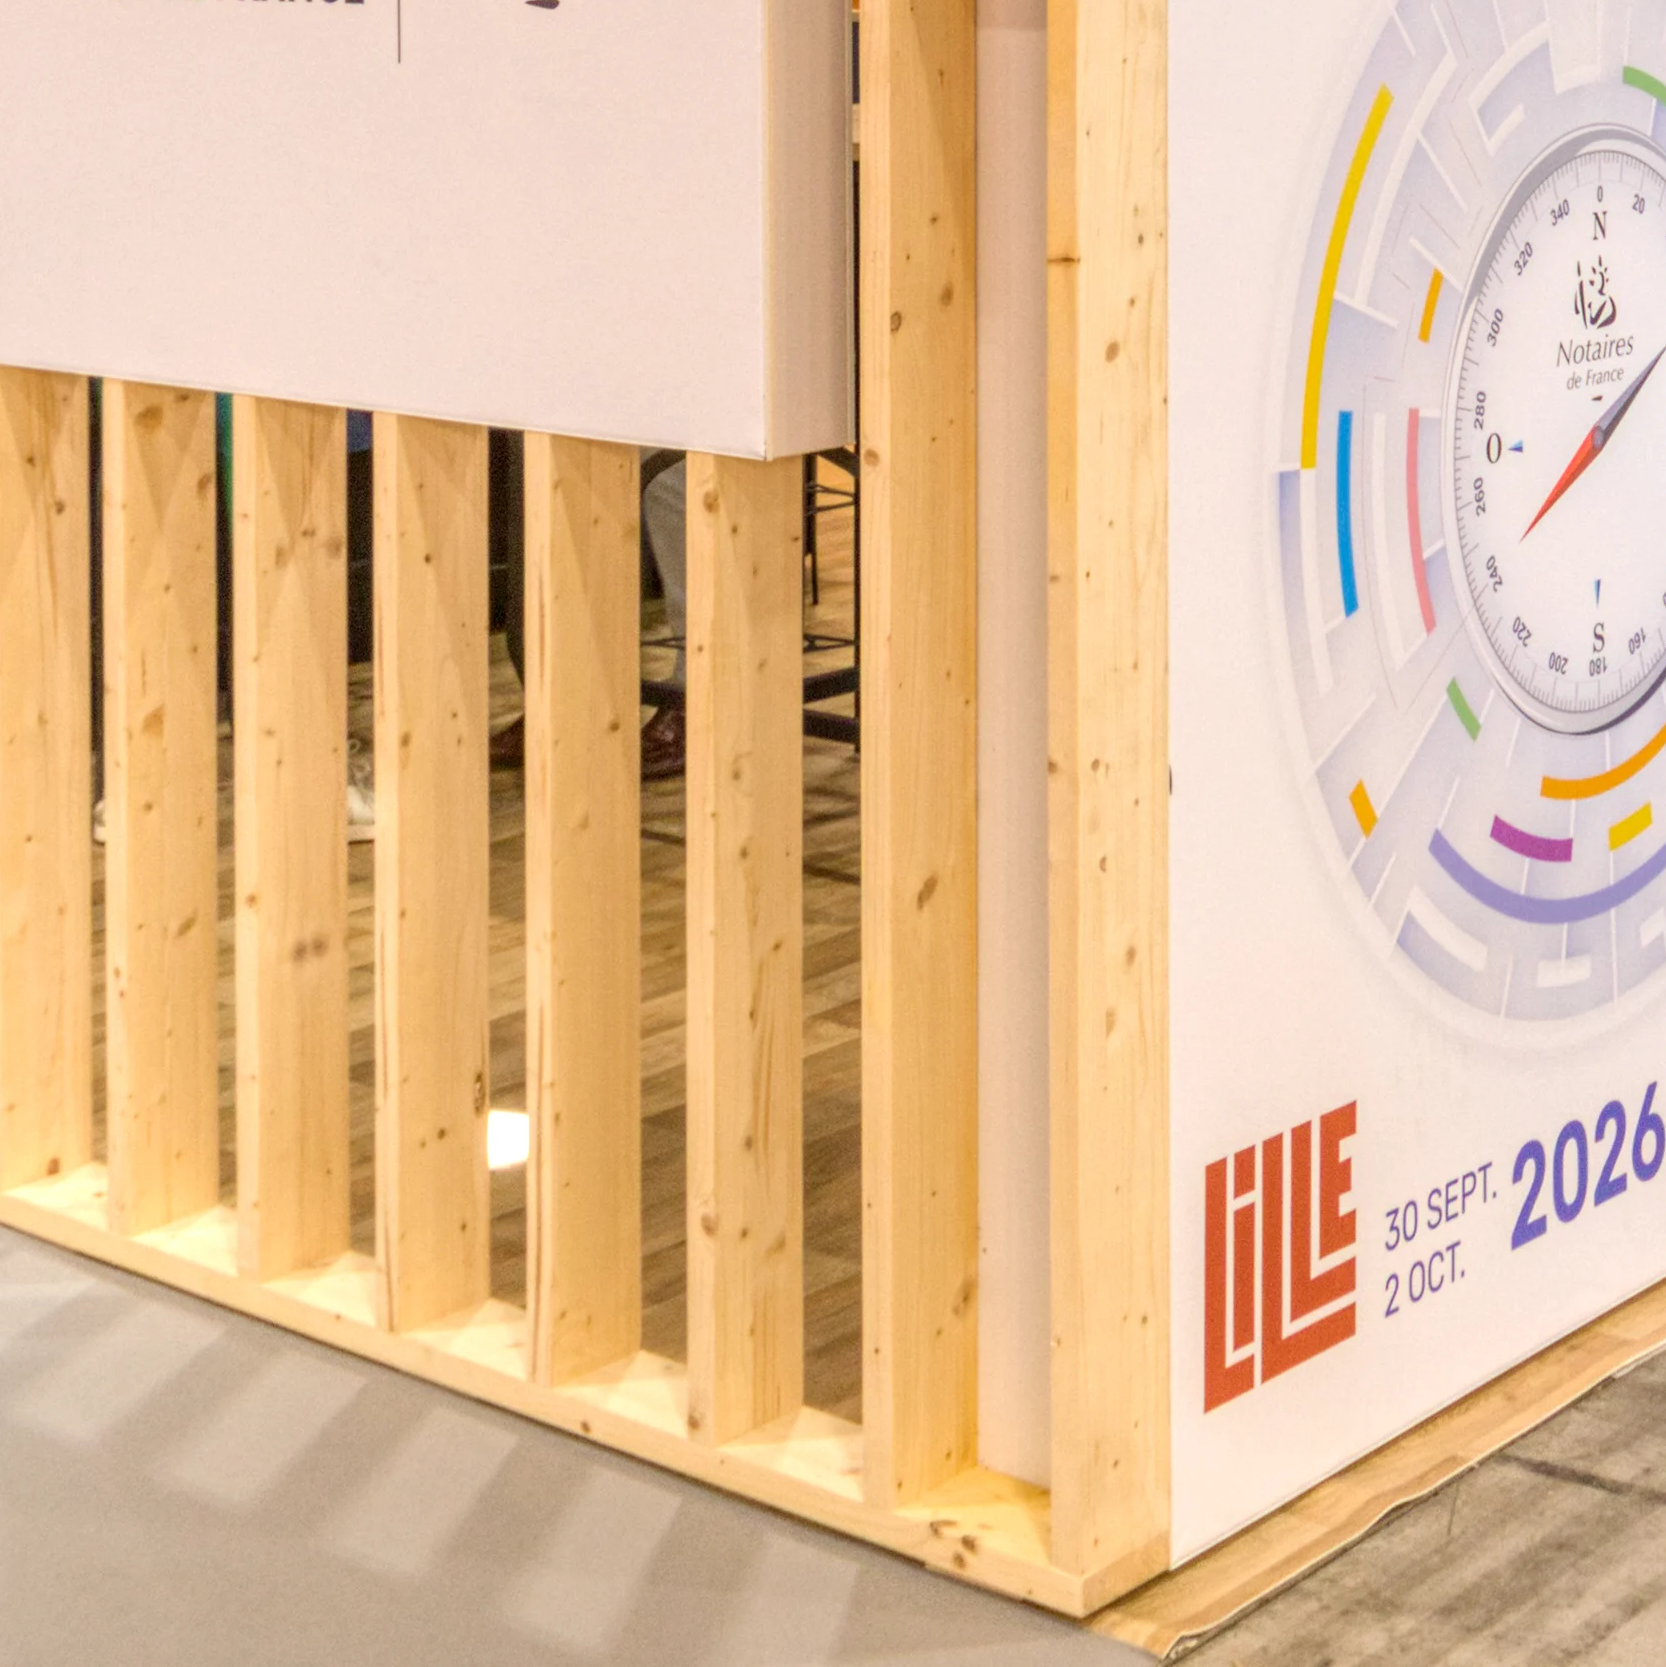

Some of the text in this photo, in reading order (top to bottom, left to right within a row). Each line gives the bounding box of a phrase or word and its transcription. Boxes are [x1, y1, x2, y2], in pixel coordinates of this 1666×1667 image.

[1597, 186, 1603, 203] 0
[1633, 194, 1645, 214] 20
[1550, 199, 1570, 226] 340
[1593, 211, 1607, 240] N
[1513, 242, 1533, 276] 320
[1487, 309, 1504, 348] 300
[1556, 334, 1633, 367] Notaires
[1567, 366, 1624, 390] de France
[1475, 391, 1486, 430] 280
[1486, 433, 1502, 463] O
[1474, 477, 1486, 516] 260
[1486, 556, 1503, 592] 240
[1513, 616, 1532, 647] 220
[1593, 623, 1605, 653] S
[1628, 627, 1647, 654] 160
[1549, 653, 1569, 675] 200
[1589, 657, 1608, 677] 180
[1510, 1080, 1666, 1251] 2026
[1384, 1161, 1498, 1252] 30 SEPT.
[1384, 1239, 1466, 1320] 2 OCT.
